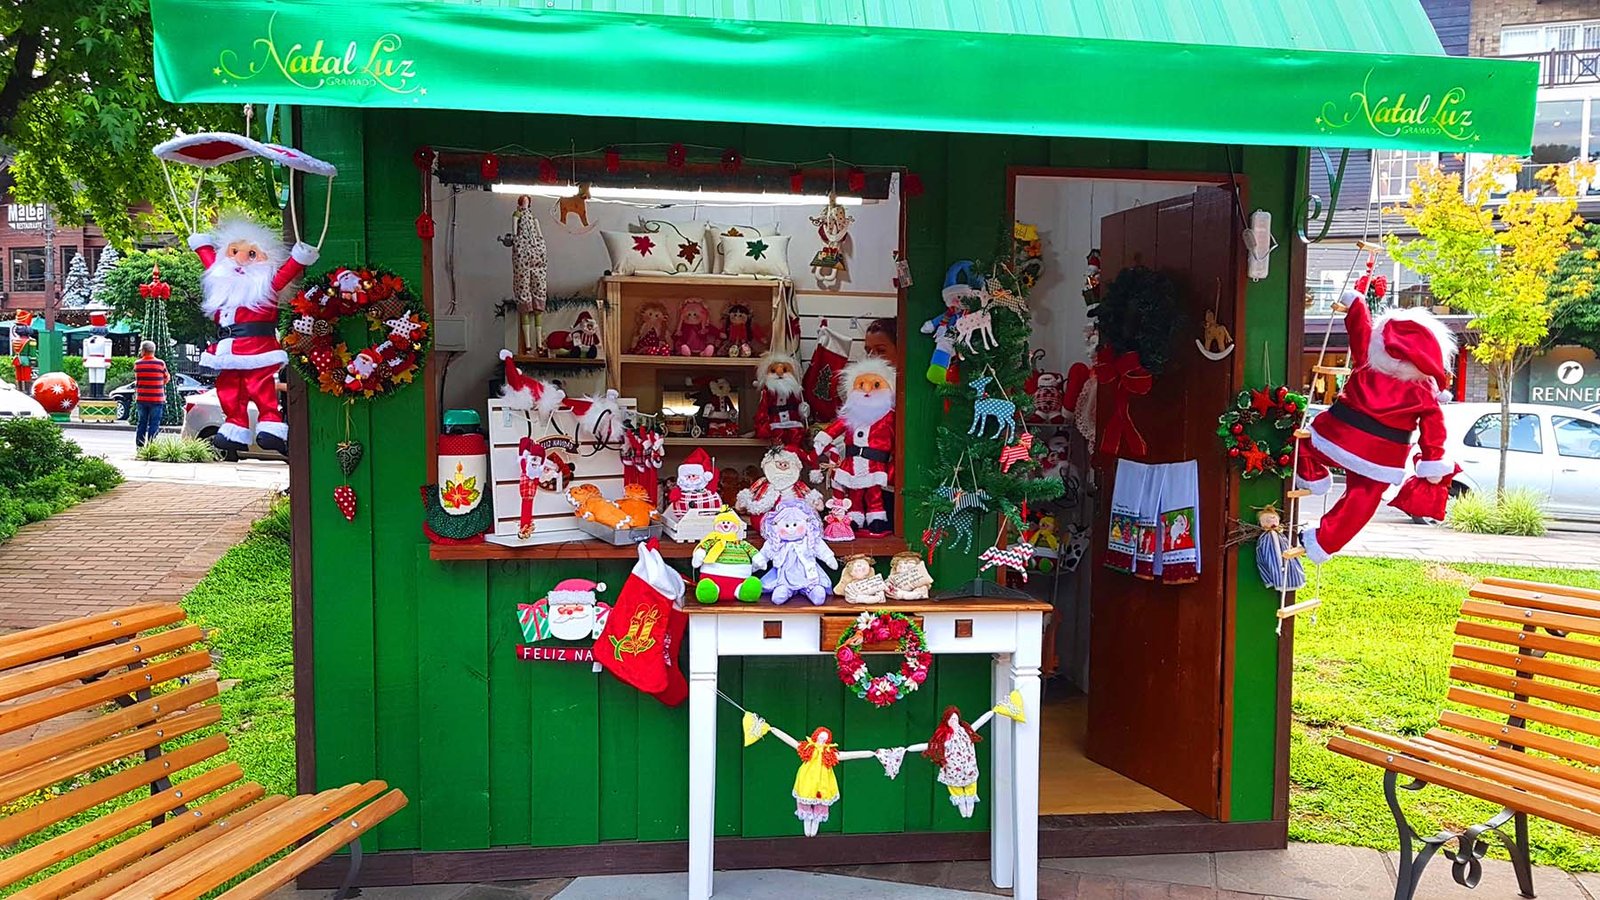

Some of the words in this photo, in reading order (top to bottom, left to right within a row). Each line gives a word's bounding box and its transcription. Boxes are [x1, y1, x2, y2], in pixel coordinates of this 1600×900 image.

[232, 20, 357, 89] Natal
[363, 33, 418, 93] Luz
[1333, 76, 1431, 137] Natal
[1431, 87, 1473, 140] Luz
[523, 647, 567, 661] FELIZ
[574, 649, 594, 662] NA
